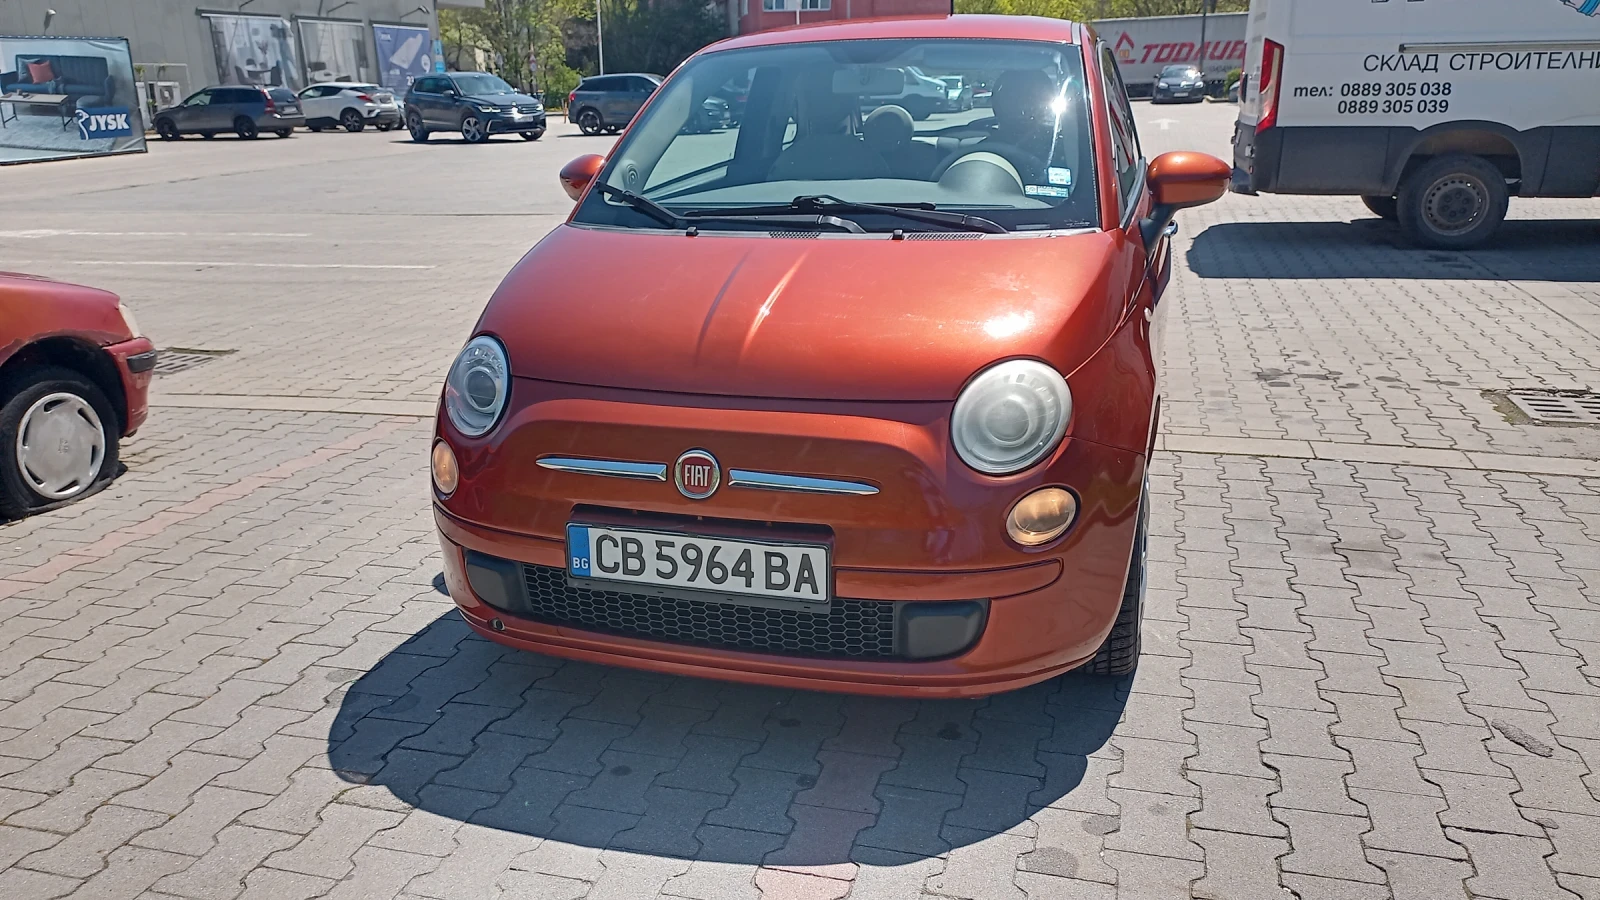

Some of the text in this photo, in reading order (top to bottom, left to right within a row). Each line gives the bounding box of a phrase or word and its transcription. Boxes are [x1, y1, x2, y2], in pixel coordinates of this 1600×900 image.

[1363, 53, 1439, 73] СКЛАД
[1293, 82, 1452, 97] тел: 0889 305 038
[1337, 99, 1449, 114] 0889 305 039
[89, 114, 130, 131] JYSK
[684, 464, 711, 487] FIAT
[572, 556, 589, 569] BG
